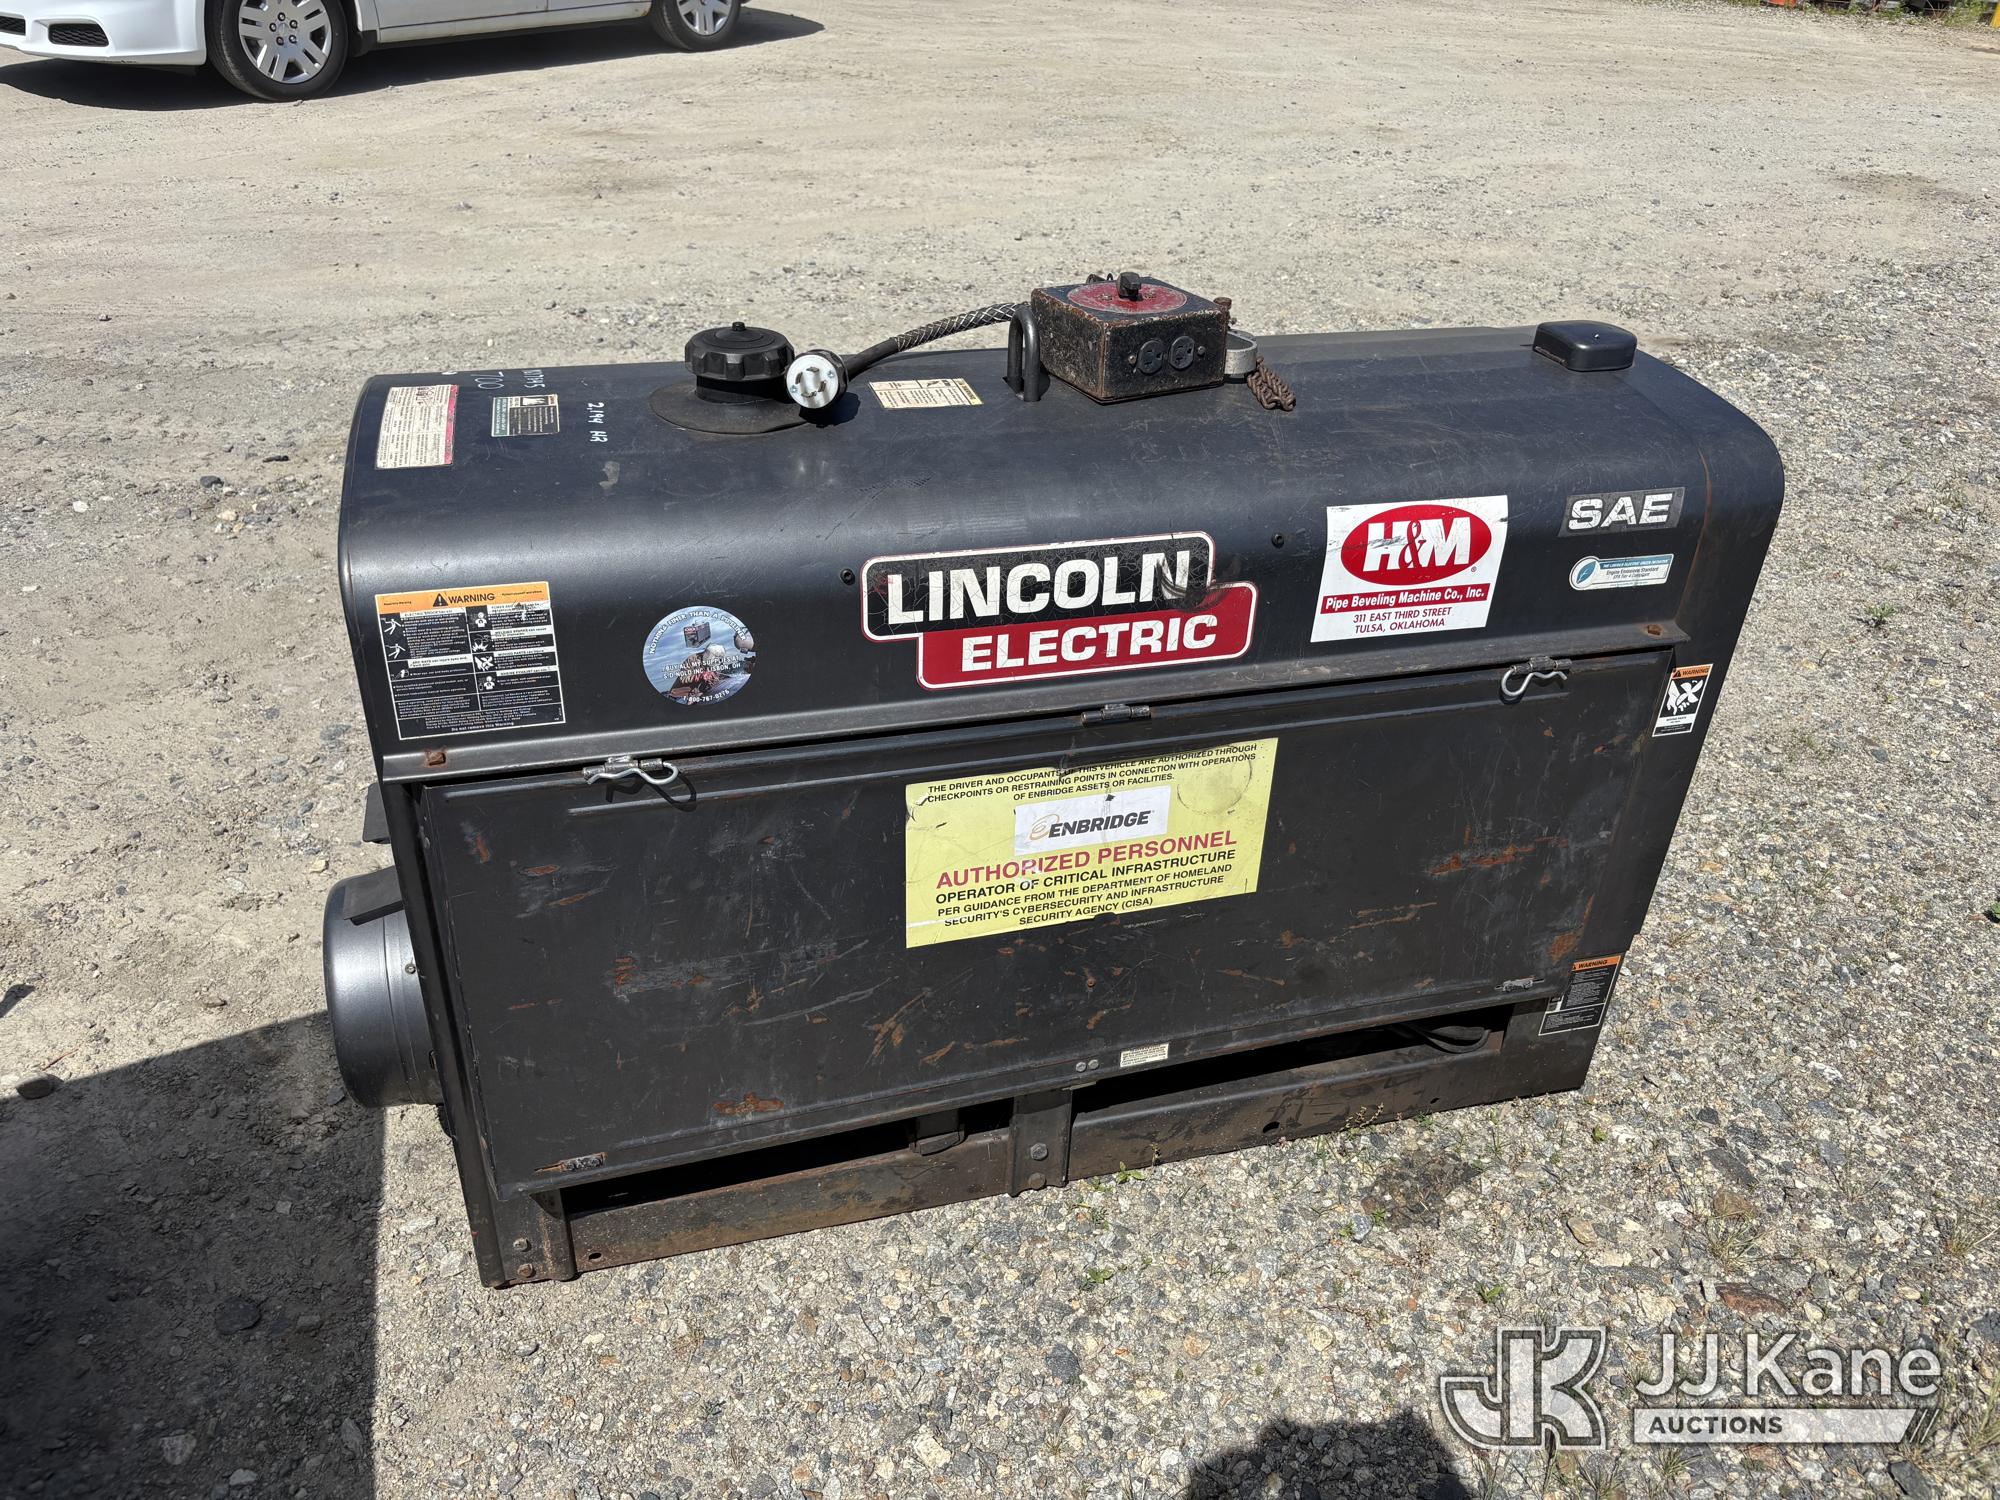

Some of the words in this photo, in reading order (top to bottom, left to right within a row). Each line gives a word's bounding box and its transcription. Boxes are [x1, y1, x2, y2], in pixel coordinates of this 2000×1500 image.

[1568, 492, 1674, 531] SAE
[1362, 516, 1472, 572] H&M
[448, 593, 495, 604] WARNING
[887, 550, 1191, 625] LINCOLN
[1326, 598, 1348, 611] Pipe
[1351, 594, 1396, 608] Beveling
[1399, 590, 1441, 604] Machine
[1444, 588, 1463, 601] Co.,
[1466, 586, 1485, 599] Inc.
[689, 610, 710, 618] THAN
[1353, 614, 1366, 623] 311
[1369, 611, 1392, 622] EAST
[1394, 609, 1420, 620] THIRD
[1423, 607, 1452, 617] STREET
[1355, 623, 1386, 634] TULSA,
[1389, 618, 1445, 631] OKLAHOMA
[961, 615, 1218, 672] ELECTRIC
[928, 784, 946, 793] THE
[949, 780, 983, 791] DRIVER
[985, 777, 1005, 786] AND
[1007, 769, 1062, 783] OCCUPANTS
[1079, 765, 1098, 774] THIS
[1100, 761, 1136, 771] VEHICLE
[1138, 757, 1156, 766] ARE
[1158, 750, 1214, 763] AUTHORIZED
[1215, 744, 1257, 756] THROUGH
[928, 788, 993, 803] CHECKPOINTS
[996, 785, 1009, 794] OR
[1011, 777, 1072, 791] RESTRAINING
[1073, 772, 1106, 783] POINTS
[1108, 770, 1117, 778] IN
[1119, 763, 1177, 777] CONNECTION
[1178, 761, 1200, 770] WITH
[1201, 752, 1257, 767] OPERATIONS
[1013, 792, 1025, 800] OF
[1028, 787, 1074, 799] ENBRIDGE
[1075, 781, 1110, 792] ASSETS
[1112, 778, 1125, 788] OR
[1127, 773, 1175, 785] FACILITIES.
[1048, 810, 1151, 838] ENBRIDGE
[935, 883, 1015, 904] OPERATOR
[1019, 879, 1040, 891] OF
[1043, 868, 1108, 887] CRITICAL
[1111, 849, 1236, 877] INFRASTRUCTURE
[936, 851, 1090, 889] AUTHORIZED
[1098, 830, 1237, 864] PERSONNEL
[938, 906, 960, 917] PER
[963, 896, 1021, 912] GUIDANCE
[1024, 891, 1055, 902] FROM
[1058, 887, 1079, 897] THE
[1082, 875, 1153, 894] DEPARTMENT
[1156, 873, 1171, 882] OF
[1173, 864, 1232, 880] HOMELAND
[944, 909, 1010, 926] SECURITY'S
[1012, 894, 1103, 915] CYBERSECURITY
[1105, 890, 1129, 900] AND
[1131, 876, 1225, 897] INFRASTRUCTURE
[1019, 909, 1073, 925] SECURITY
[1075, 903, 1119, 916] AGENCY
[1121, 897, 1153, 910] (CISA)
[1579, 960, 1608, 969] WARNING
